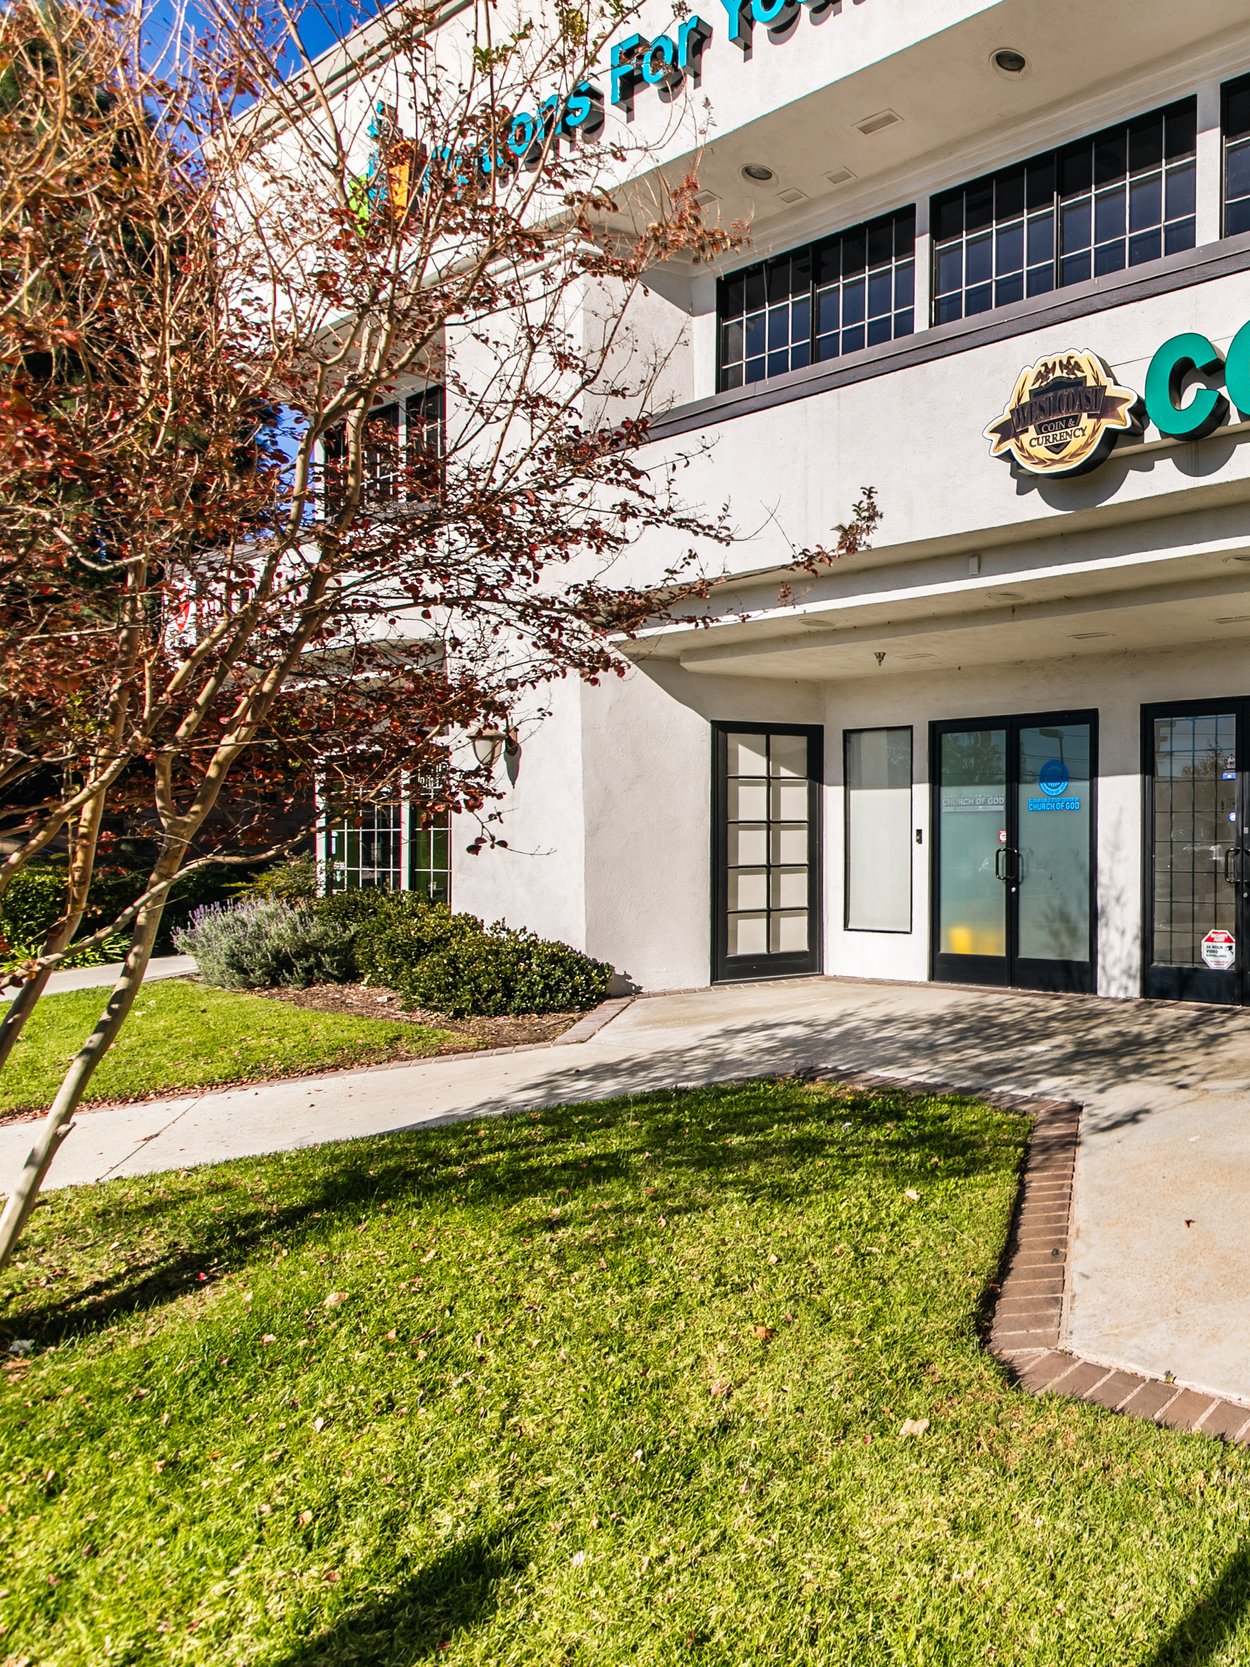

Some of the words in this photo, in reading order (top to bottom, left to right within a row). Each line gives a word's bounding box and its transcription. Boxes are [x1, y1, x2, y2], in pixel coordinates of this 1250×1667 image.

[611, 15, 699, 105] For
[1011, 394, 1055, 431] WEST
[1056, 385, 1104, 415] COAST
[1041, 420, 1066, 433] COIN
[1067, 418, 1076, 428] &
[1029, 426, 1087, 447] CURRENCY
[943, 798, 974, 806] CHURCH
[975, 797, 987, 805] OF
[987, 797, 1005, 805] GOD
[1028, 802, 1056, 811] CHURCH
[1056, 802, 1065, 810] OF
[1065, 801, 1080, 810] GOD
